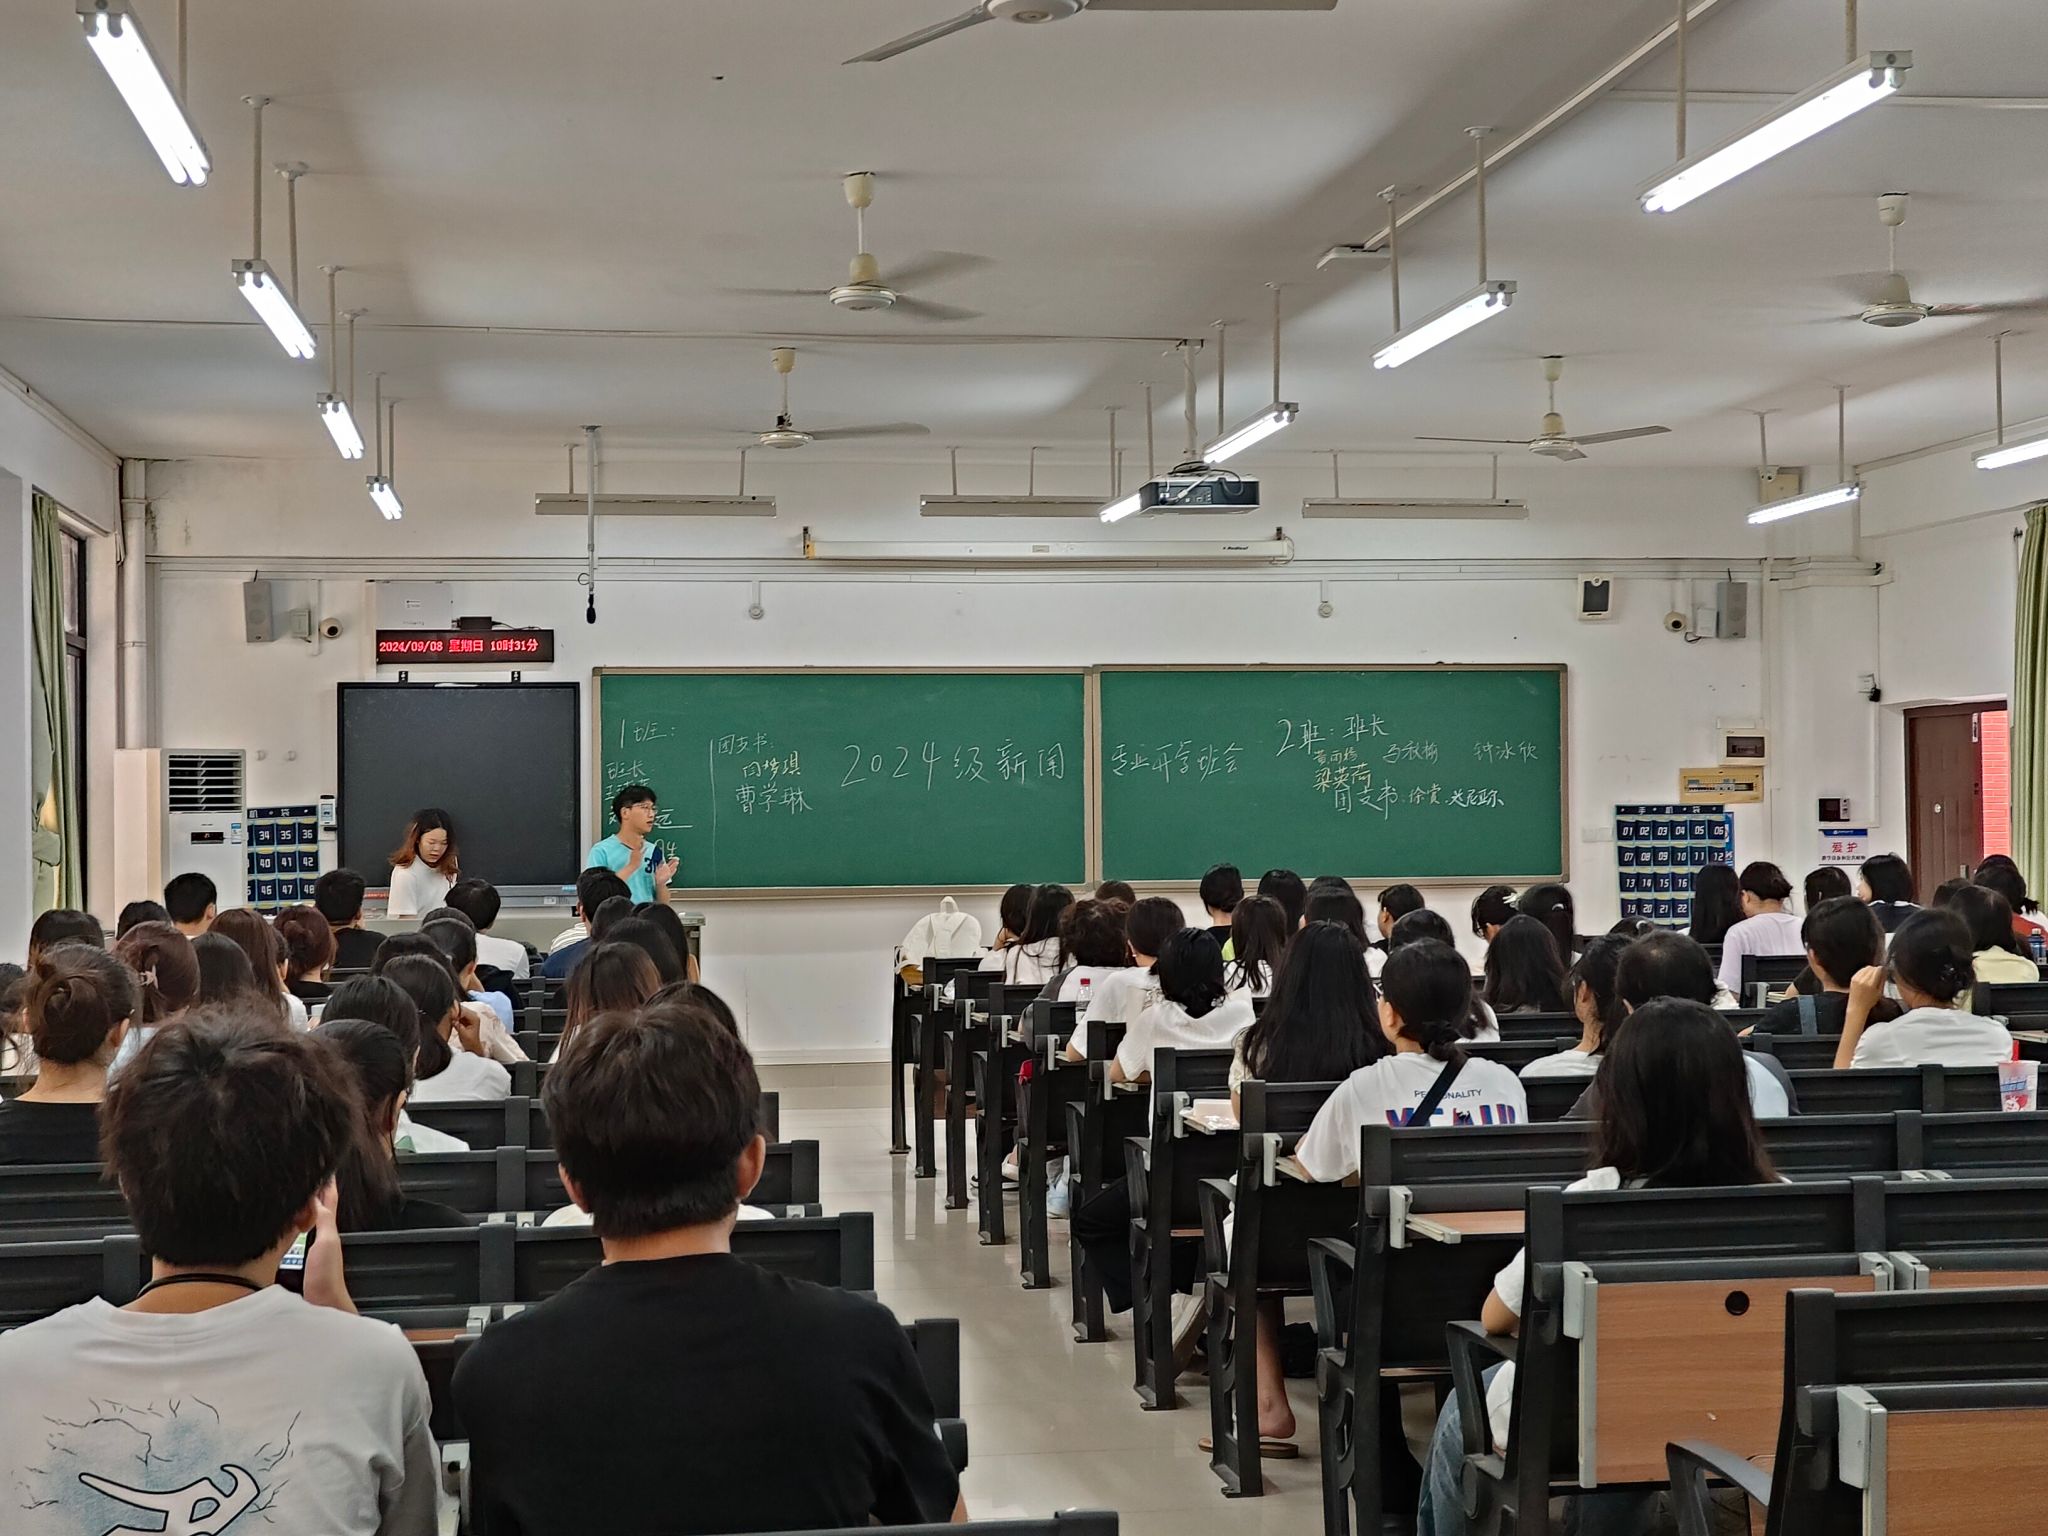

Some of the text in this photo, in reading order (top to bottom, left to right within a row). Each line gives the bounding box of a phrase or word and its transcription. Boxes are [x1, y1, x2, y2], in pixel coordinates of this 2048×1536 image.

[379, 639, 539, 653] 2024/09/08 星期日 10时31分
[1342, 713, 1390, 742] 班长
[840, 738, 1065, 792] 2024级新闻
[1111, 740, 1244, 783] 专业开学班会
[258, 829, 313, 840] 34 35 36
[1622, 825, 1724, 836] 01 02 03 04 05 06
[259, 856, 314, 868] 40 41 42
[1624, 852, 1634, 862] 07
[1640, 852, 1651, 861] 08
[1658, 851, 1668, 861] 09
[1677, 852, 1687, 861] 10
[1695, 851, 1704, 861] 11
[1713, 852, 1724, 861] 12
[1626, 879, 1636, 888] 13
[1659, 878, 1669, 888] 15
[1678, 878, 1688, 888] 16
[261, 885, 272, 895] 46
[282, 884, 293, 895] 47
[1627, 904, 1687, 914] 19 20 21 22
[1414, 1089, 1482, 1099] PENALITY
